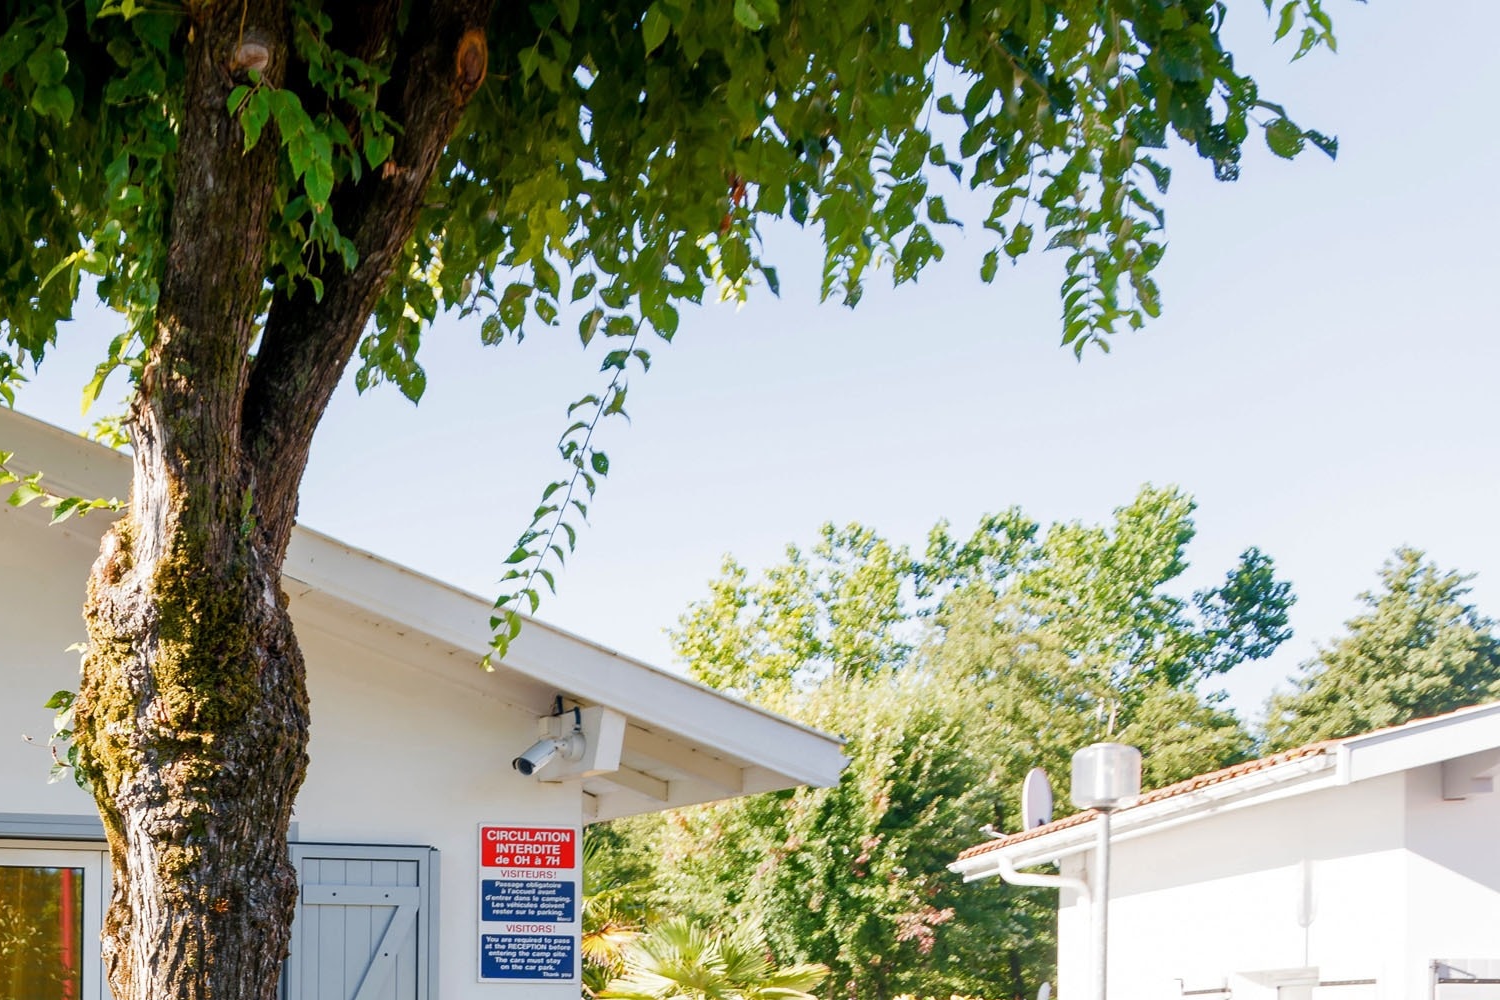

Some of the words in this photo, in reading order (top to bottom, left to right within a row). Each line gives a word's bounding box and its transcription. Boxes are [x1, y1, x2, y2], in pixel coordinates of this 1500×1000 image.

[486, 830, 571, 842] CIRCULATION
[495, 843, 561, 855] INTERDITE
[495, 855, 510, 864] de
[534, 856, 541, 865] à
[545, 856, 561, 865] 7H
[500, 870, 557, 879] VISITEURS!
[506, 924, 556, 933] VISITORS!
